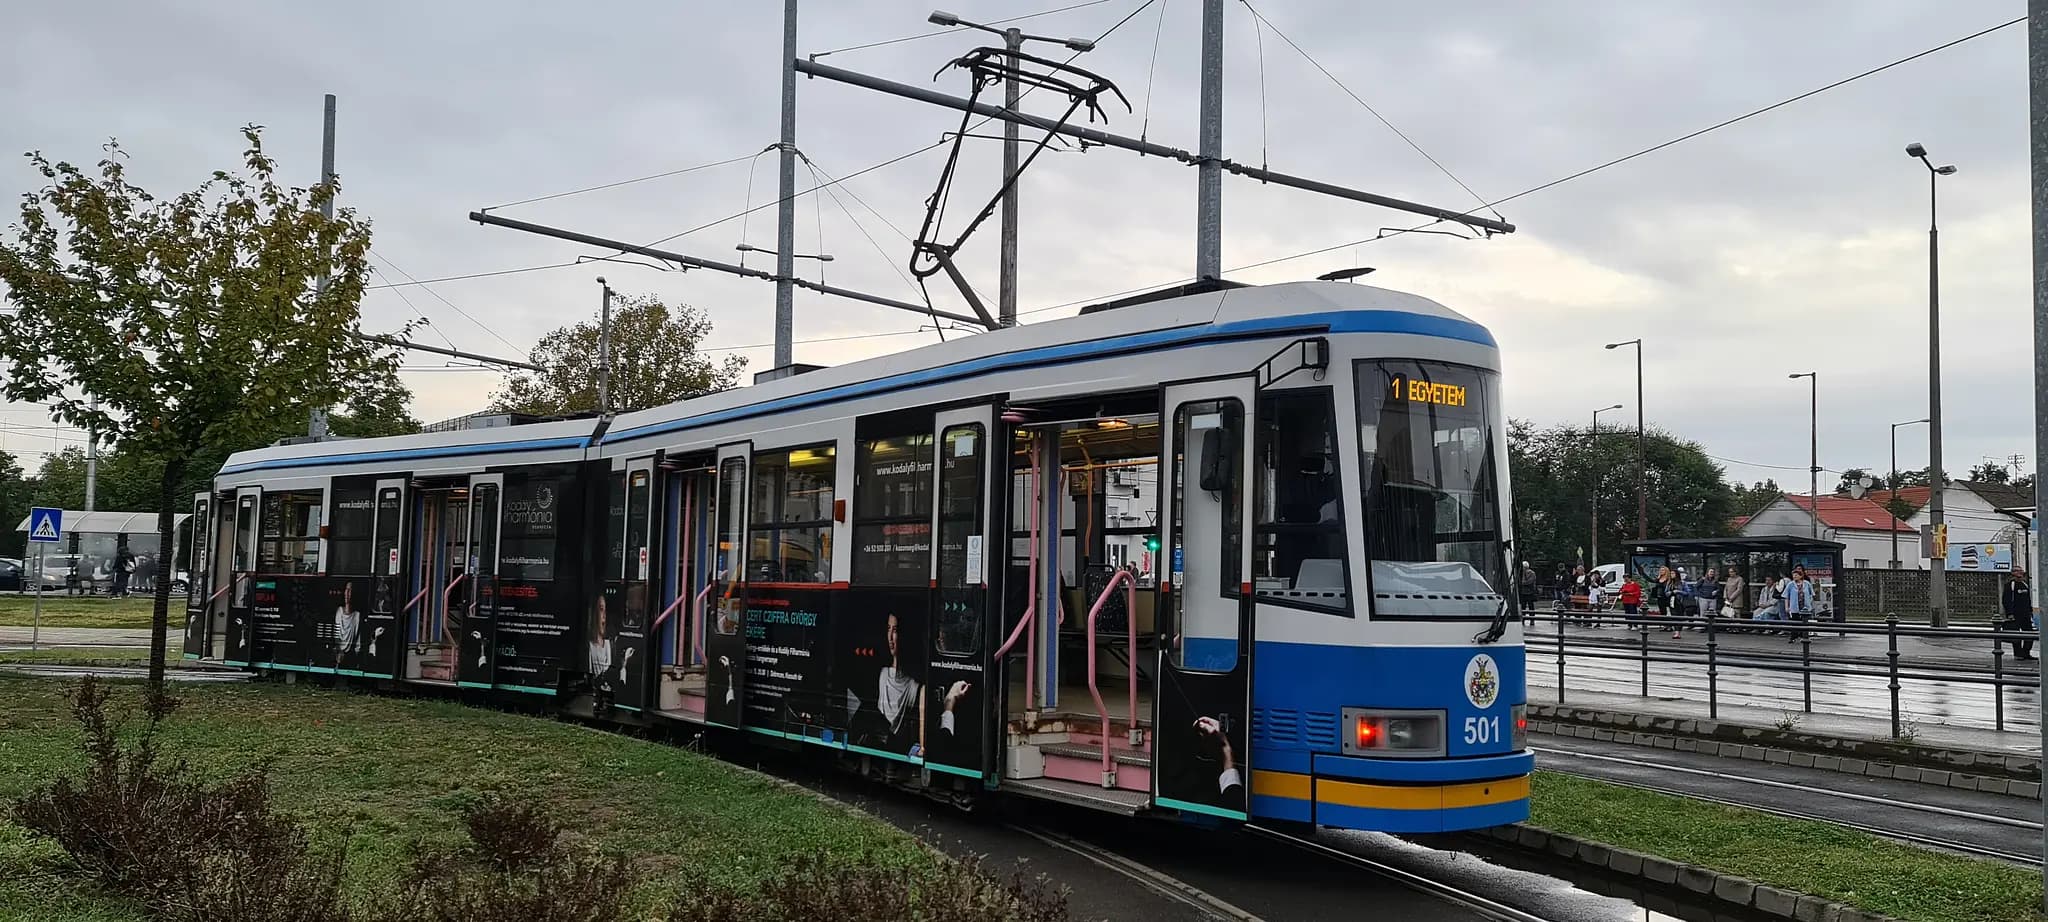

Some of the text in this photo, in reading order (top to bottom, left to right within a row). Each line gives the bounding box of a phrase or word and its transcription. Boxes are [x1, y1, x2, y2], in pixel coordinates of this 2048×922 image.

[1392, 378, 1466, 407] 1 EGYETEM
[763, 610, 790, 625] CZIFFRA
[790, 609, 817, 627] GYÖRGY
[1464, 716, 1500, 745] 501
